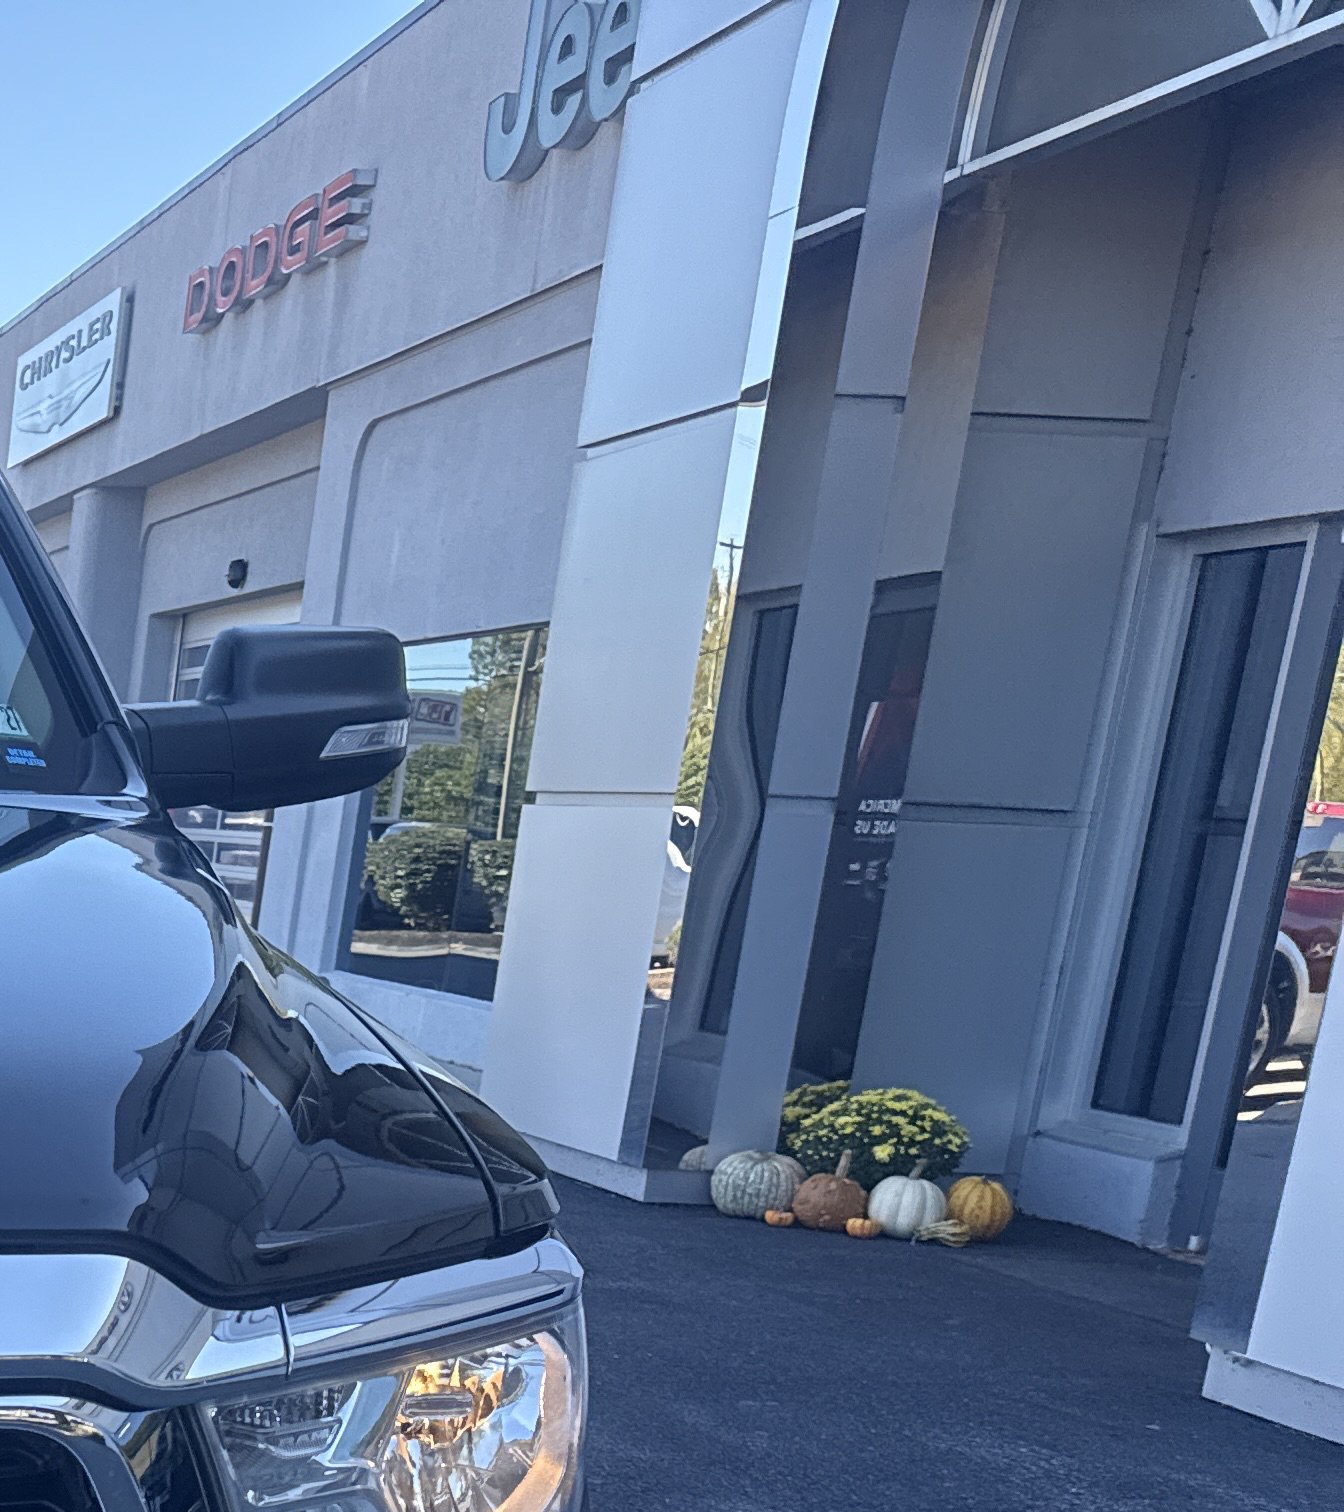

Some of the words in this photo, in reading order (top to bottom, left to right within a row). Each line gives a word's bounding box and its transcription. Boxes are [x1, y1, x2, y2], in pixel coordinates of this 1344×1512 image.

[484, 0, 640, 182] Jee
[183, 168, 374, 334] DODGE
[19, 310, 113, 391] CHRYSLER
